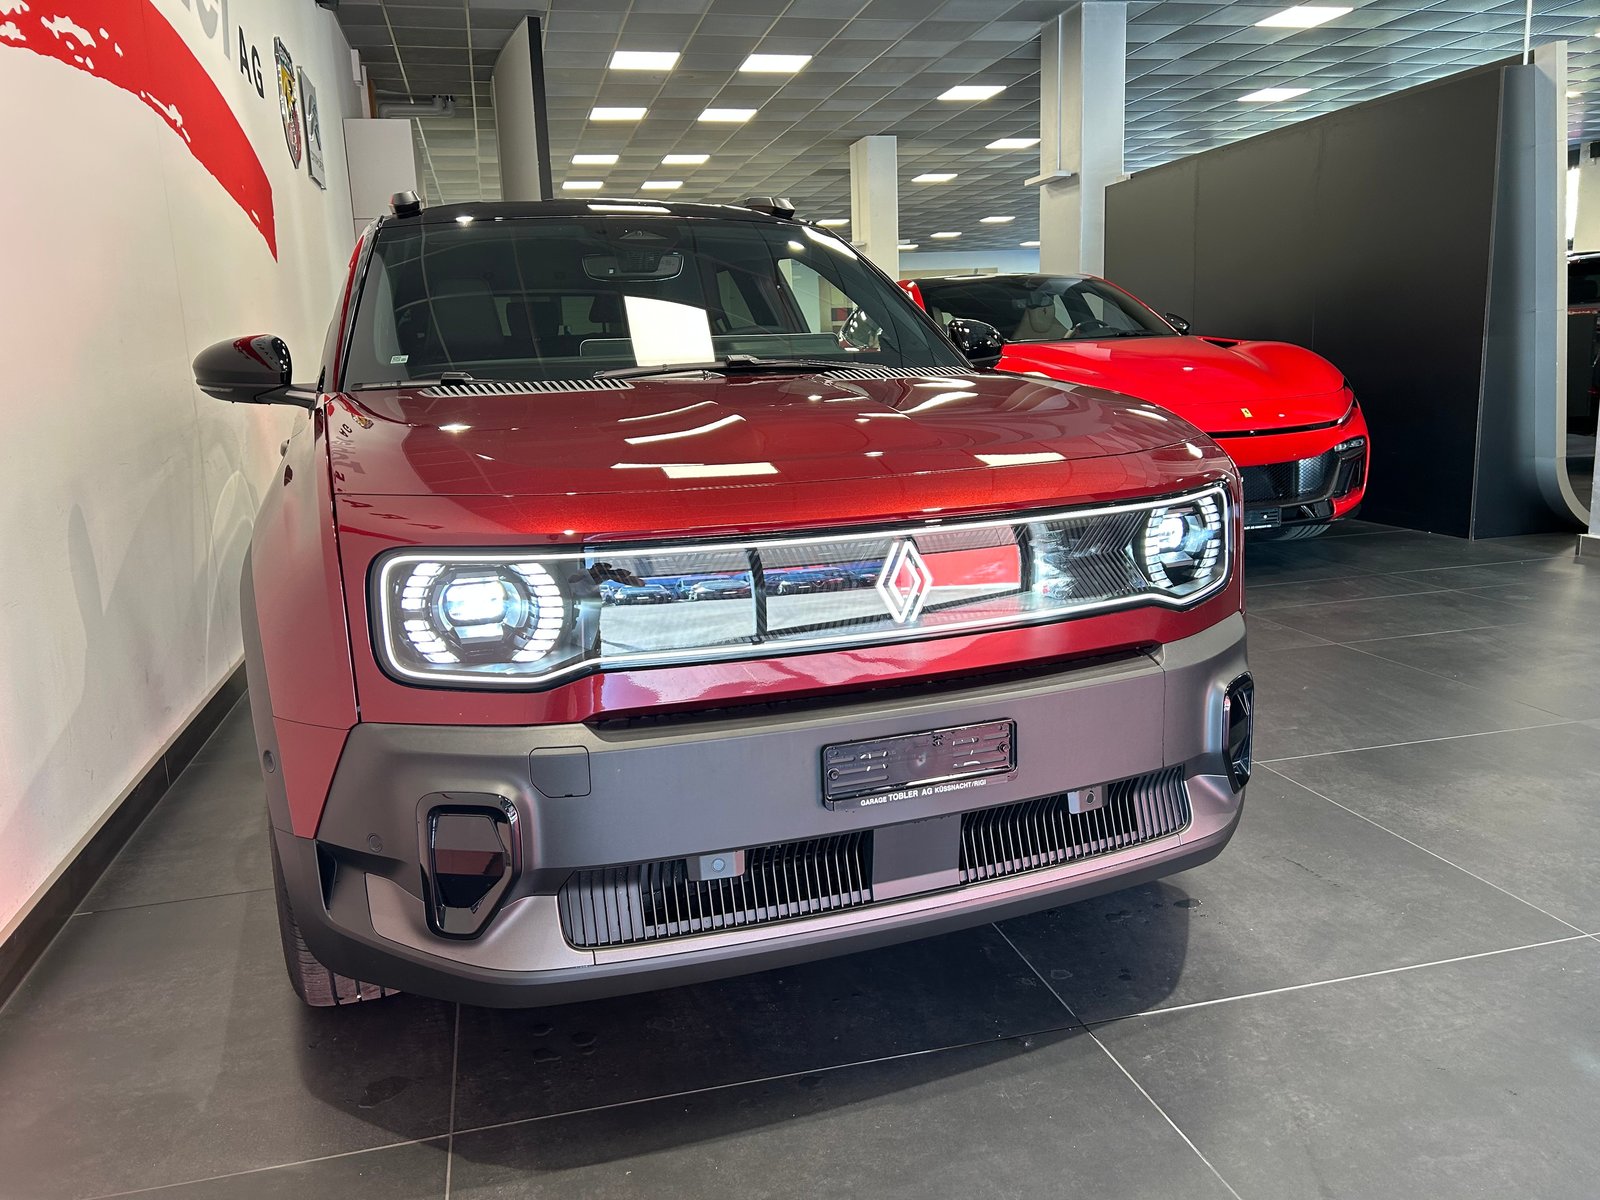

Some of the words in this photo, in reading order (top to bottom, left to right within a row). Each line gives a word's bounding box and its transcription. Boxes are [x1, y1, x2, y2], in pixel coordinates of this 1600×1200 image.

[238, 25, 264, 99] AG
[860, 796, 888, 806] GARAGE
[888, 790, 919, 802] TOBLER
[921, 787, 933, 796] AG
[934, 779, 987, 794] KÜSSNACHT/RIGI
